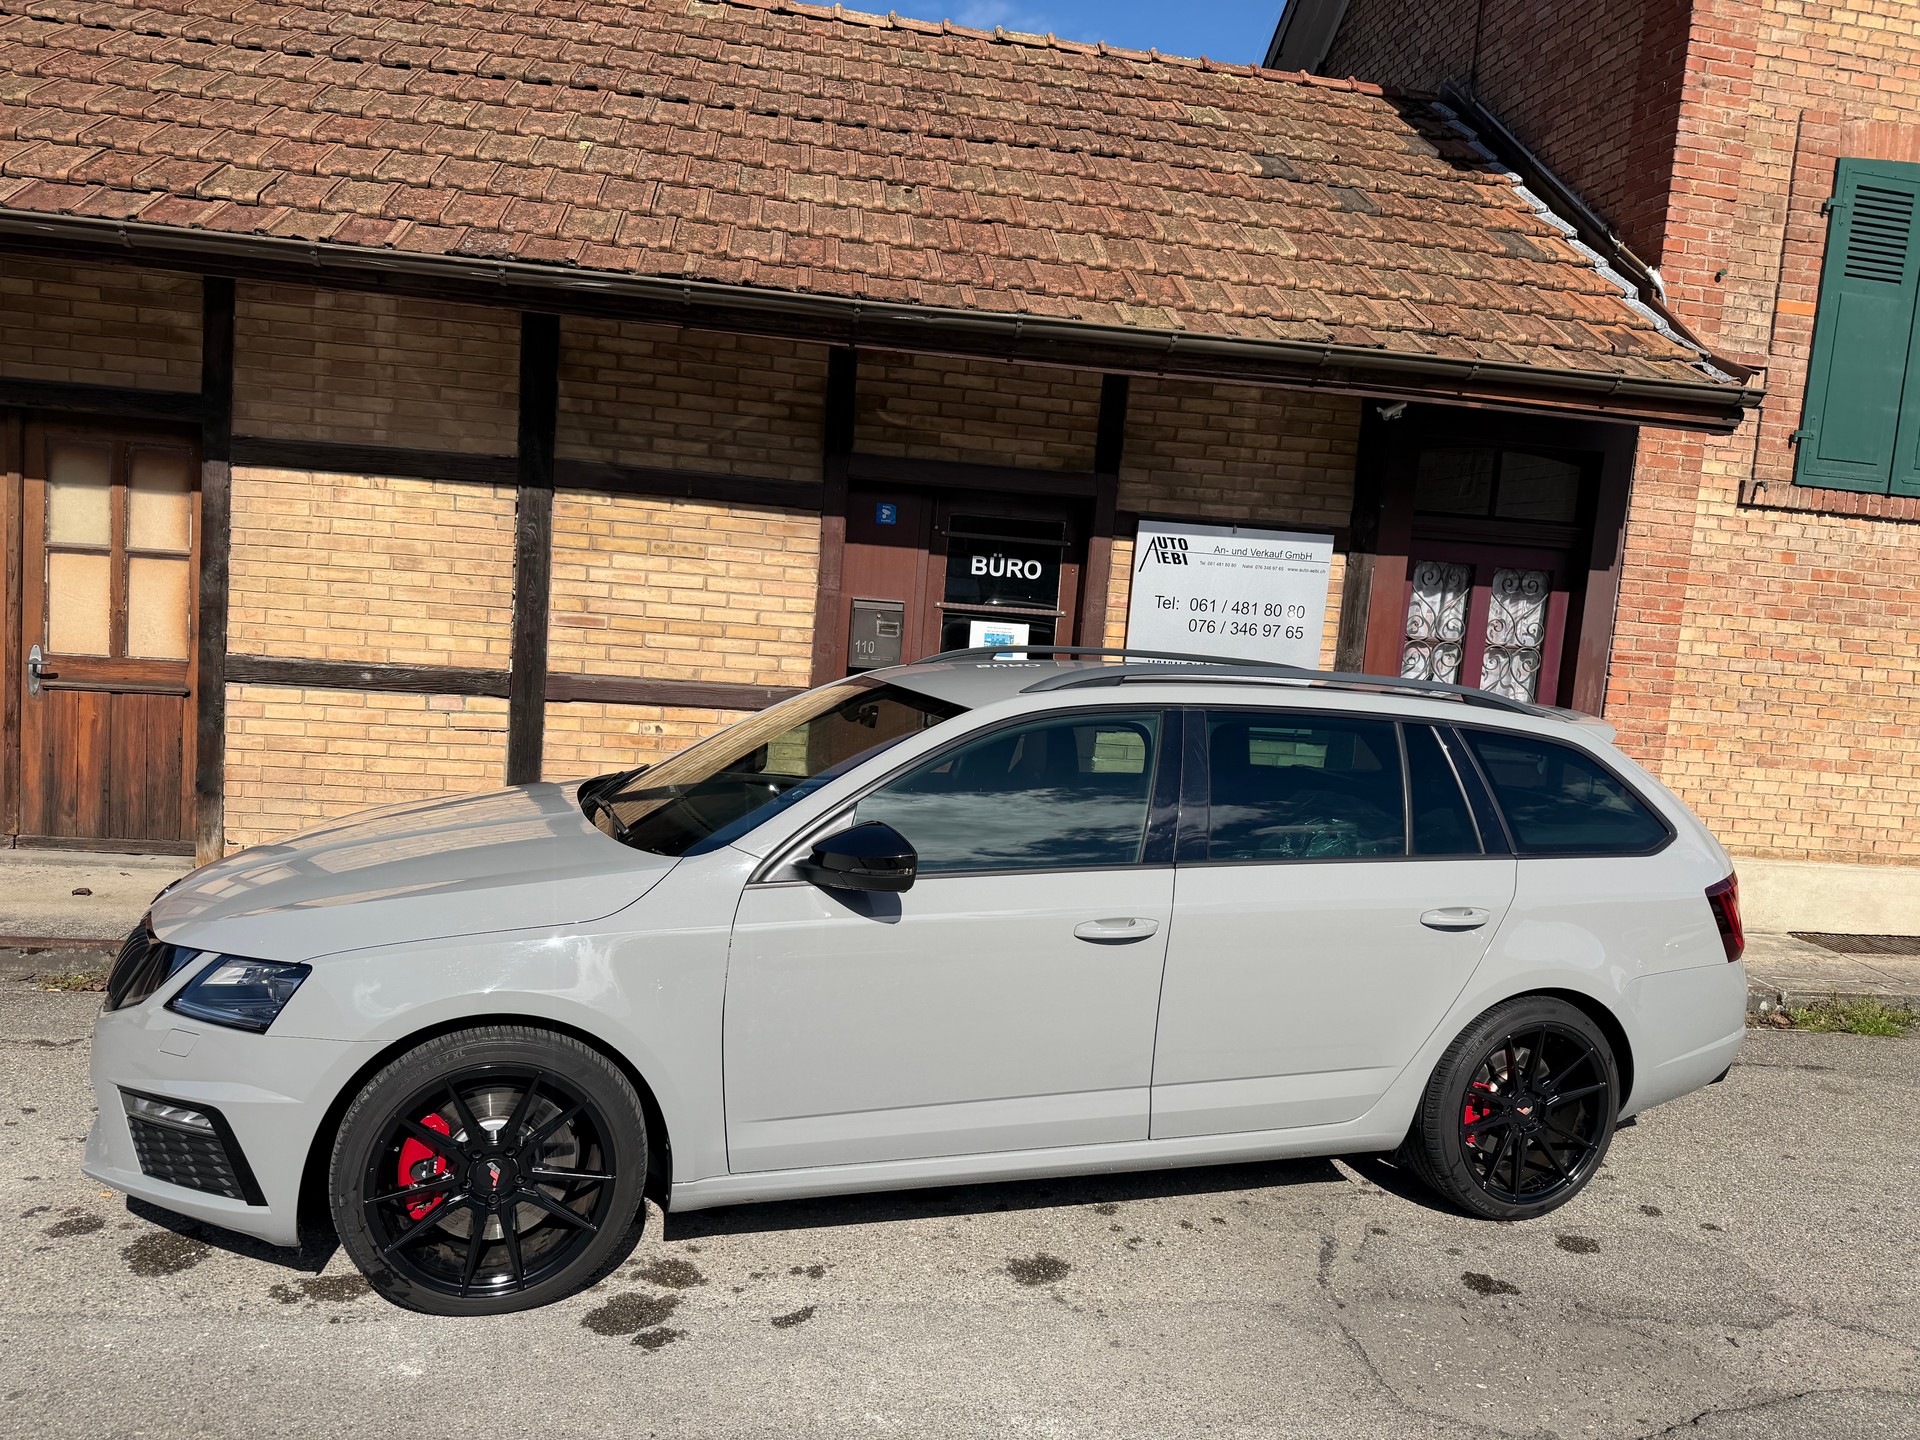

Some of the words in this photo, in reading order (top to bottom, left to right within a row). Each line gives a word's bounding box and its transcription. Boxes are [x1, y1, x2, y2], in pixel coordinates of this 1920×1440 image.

[1213, 545, 1229, 554] An-
[1231, 547, 1248, 556] und
[1250, 549, 1284, 559] Verkauf
[1285, 551, 1313, 561] GmbH
[970, 553, 1042, 579] BÜRO
[1154, 595, 1180, 610] Tel:
[1189, 598, 1217, 613] 061
[1221, 600, 1228, 613] /
[1231, 601, 1258, 616] 481
[1263, 603, 1282, 617] 80
[1287, 604, 1306, 619] 80
[1188, 618, 1216, 634] 076
[1220, 620, 1227, 634] /
[1230, 621, 1258, 637] 346
[1262, 624, 1280, 638] 97
[1285, 625, 1304, 640] 65
[855, 639, 875, 654] 110
